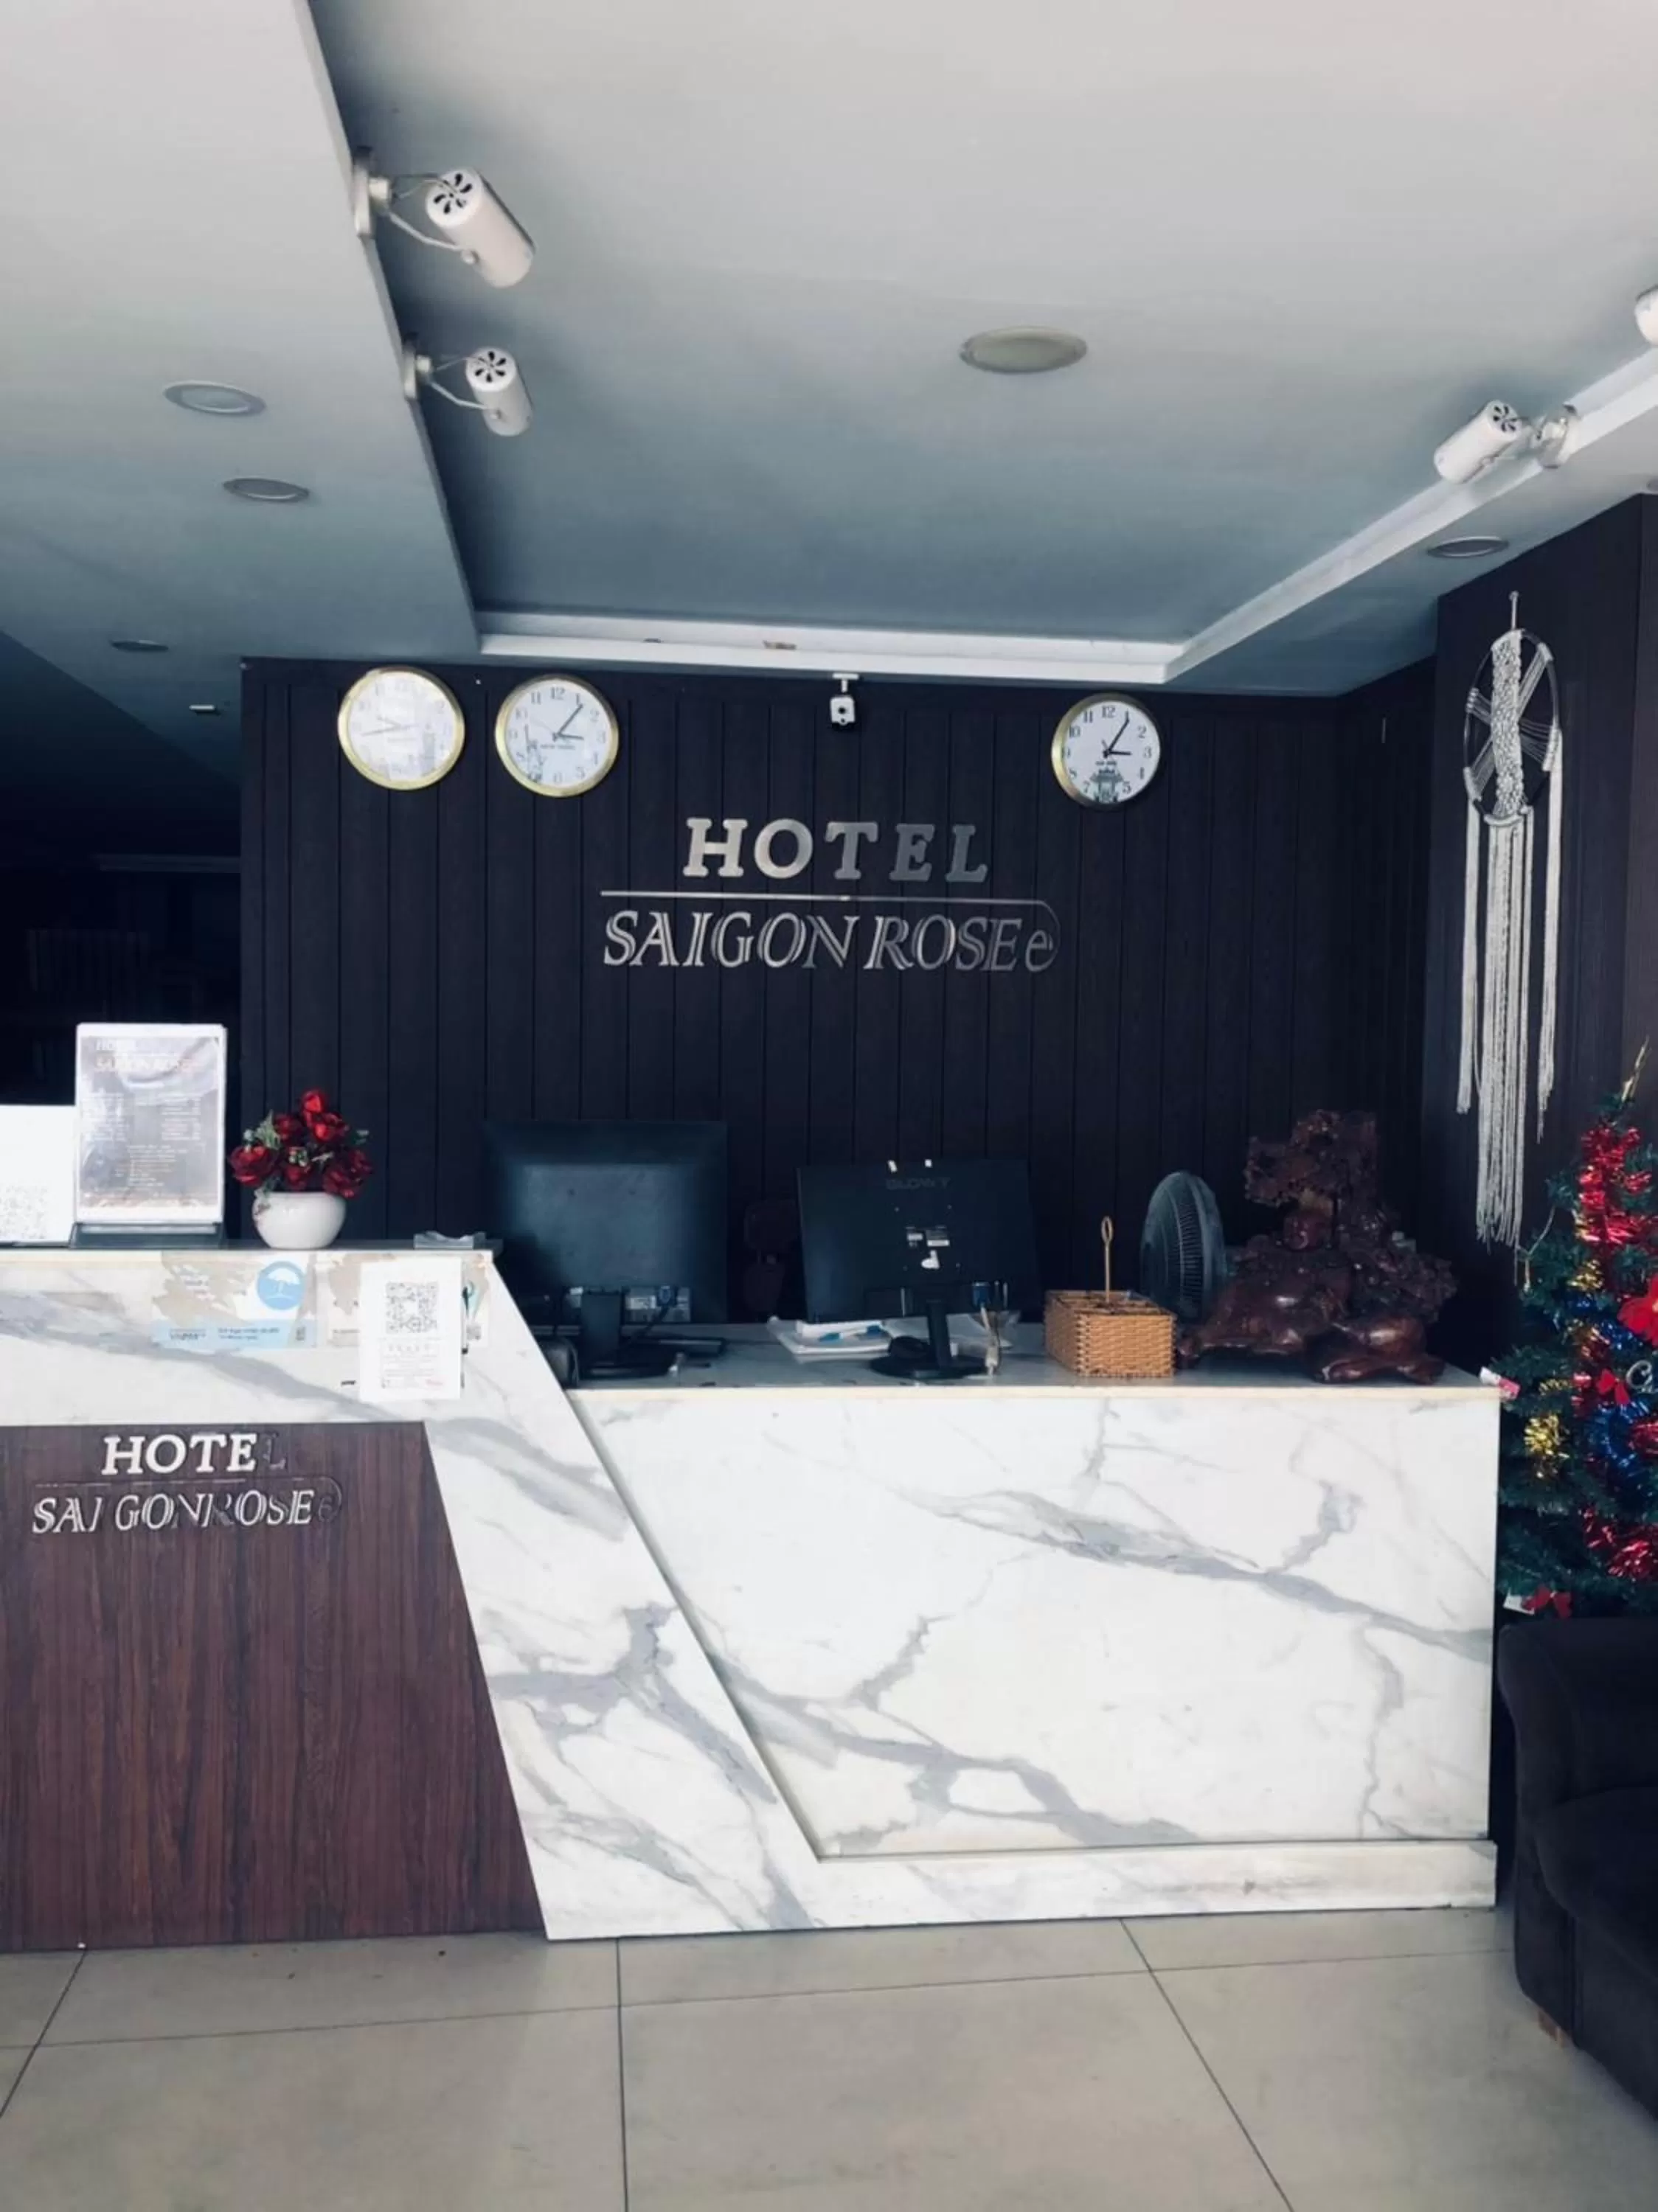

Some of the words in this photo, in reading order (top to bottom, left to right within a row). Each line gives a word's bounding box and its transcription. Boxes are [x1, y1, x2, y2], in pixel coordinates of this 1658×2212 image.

[531, 692, 541, 705] 11
[551, 687, 565, 700] 12
[590, 709, 600, 723] 2
[1083, 710, 1093, 723] 11
[1102, 705, 1116, 718] 12
[1069, 726, 1081, 738] 10
[1138, 726, 1147, 739] 2
[1144, 747, 1152, 759] 3
[1123, 781, 1131, 794] 5
[683, 818, 988, 883] HOTEL
[603, 910, 856, 969] SAIGON
[101, 1432, 288, 1475] HOTEL
